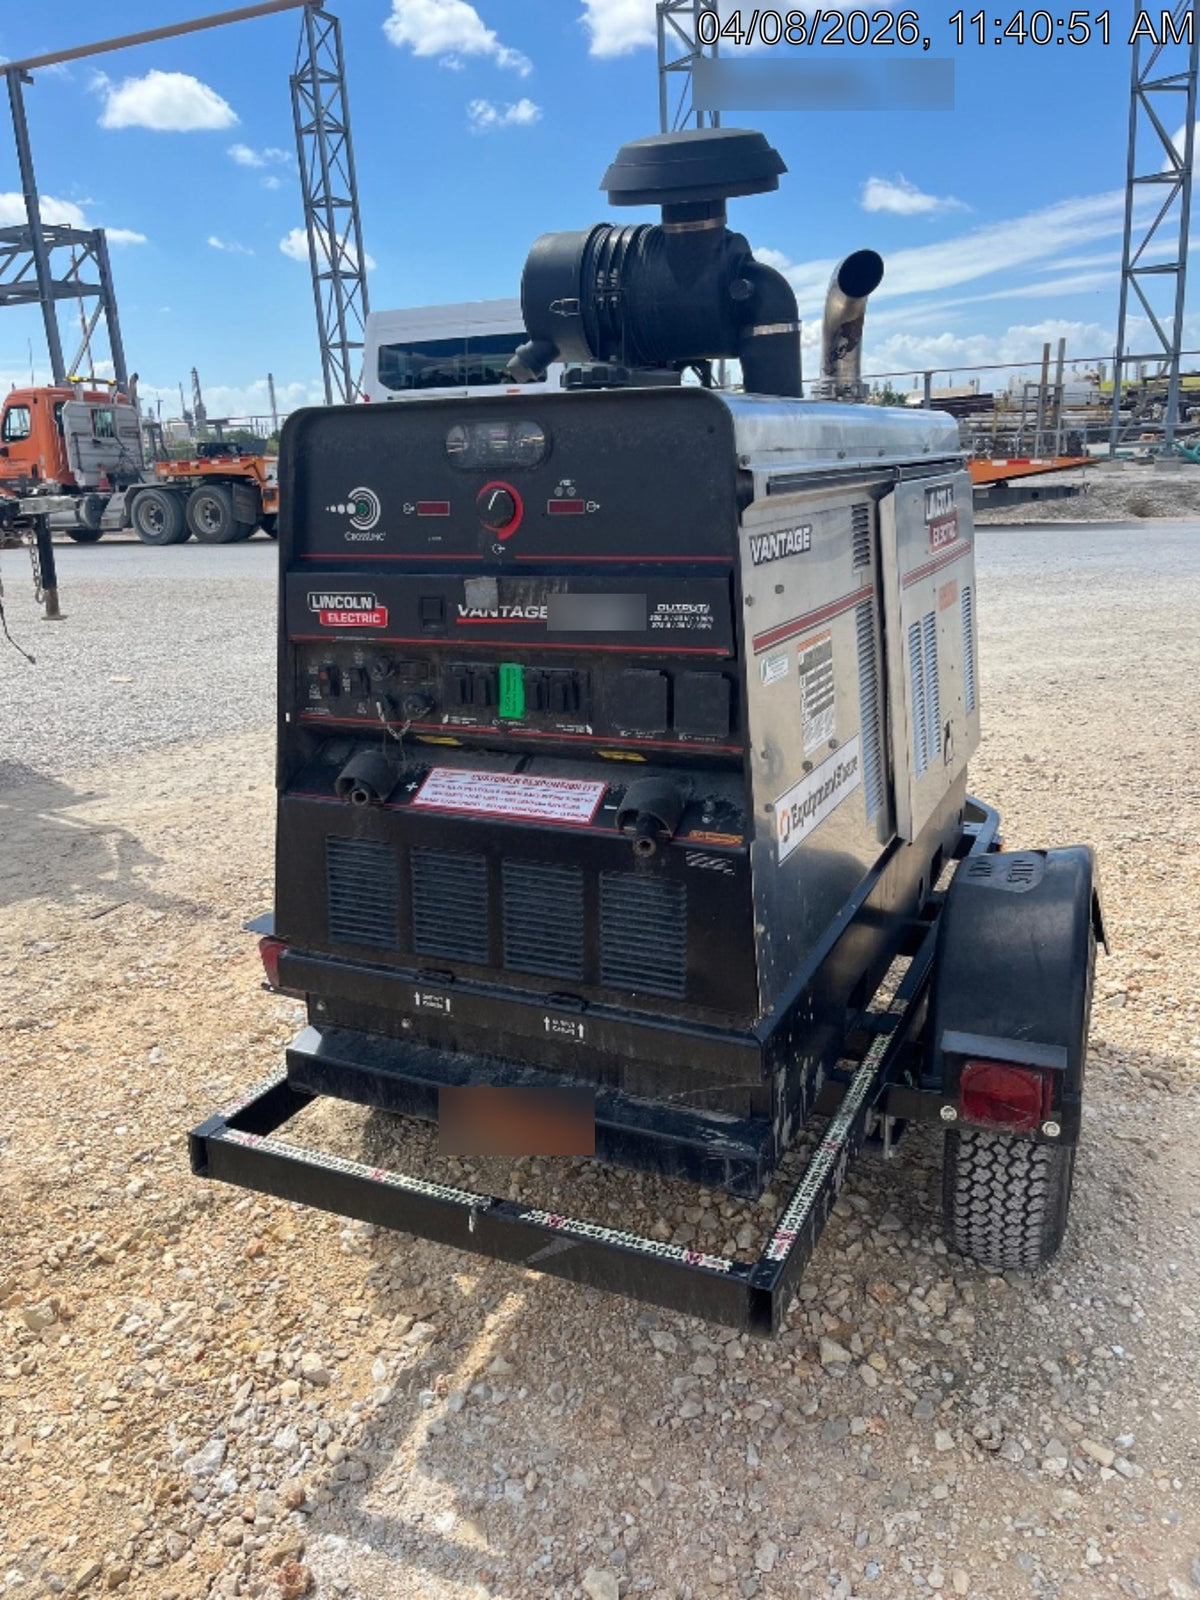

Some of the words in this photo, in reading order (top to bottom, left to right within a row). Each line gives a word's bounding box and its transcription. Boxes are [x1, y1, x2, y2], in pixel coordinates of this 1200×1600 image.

[750, 526, 811, 564] VANTAGE
[311, 595, 373, 609] LINCOLN
[327, 612, 382, 623] ELECTRIC
[457, 604, 548, 619] VANTAGE
